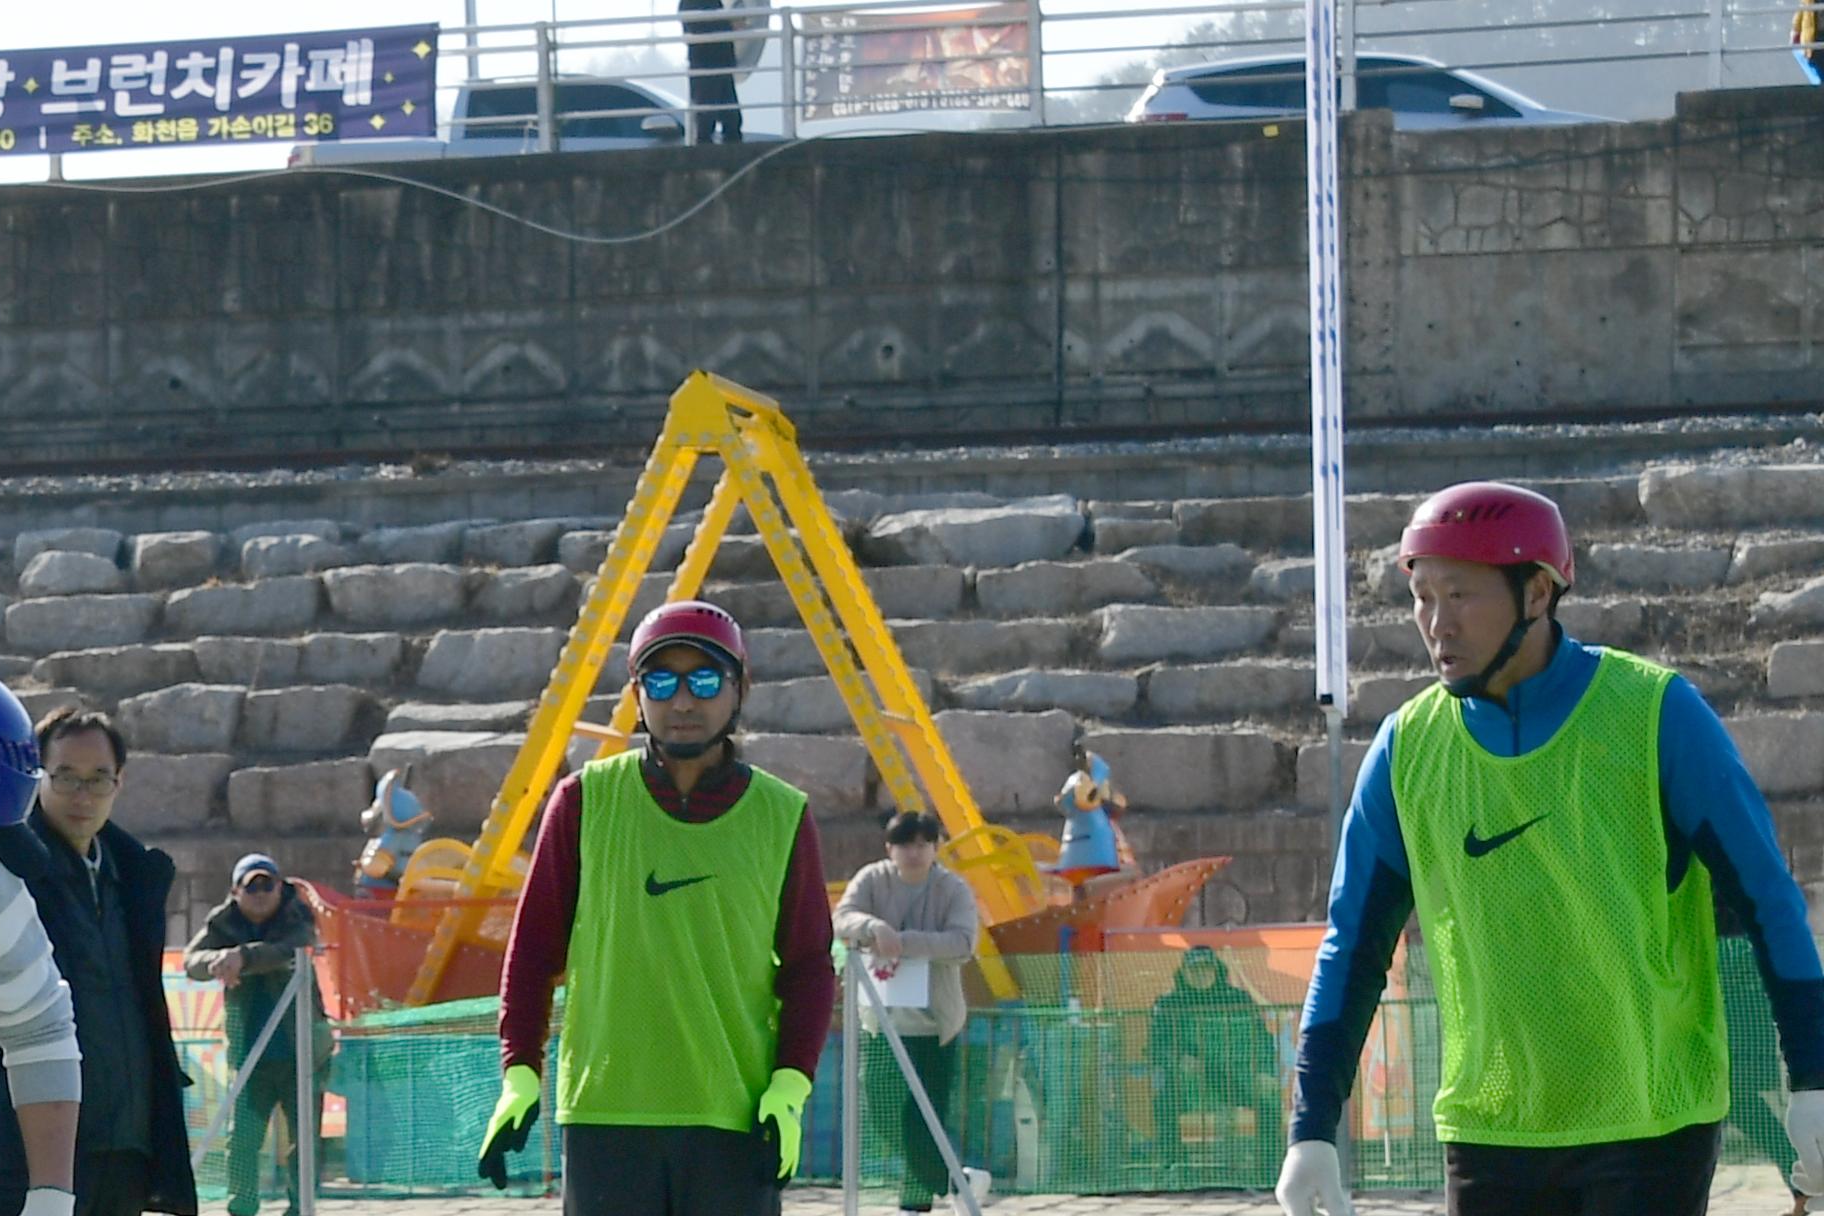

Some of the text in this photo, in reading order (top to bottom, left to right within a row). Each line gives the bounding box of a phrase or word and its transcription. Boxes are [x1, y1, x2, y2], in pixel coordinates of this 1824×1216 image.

[41, 38, 374, 117] 브런치카페
[132, 117, 199, 143] 화천읍
[304, 112, 333, 135] 36
